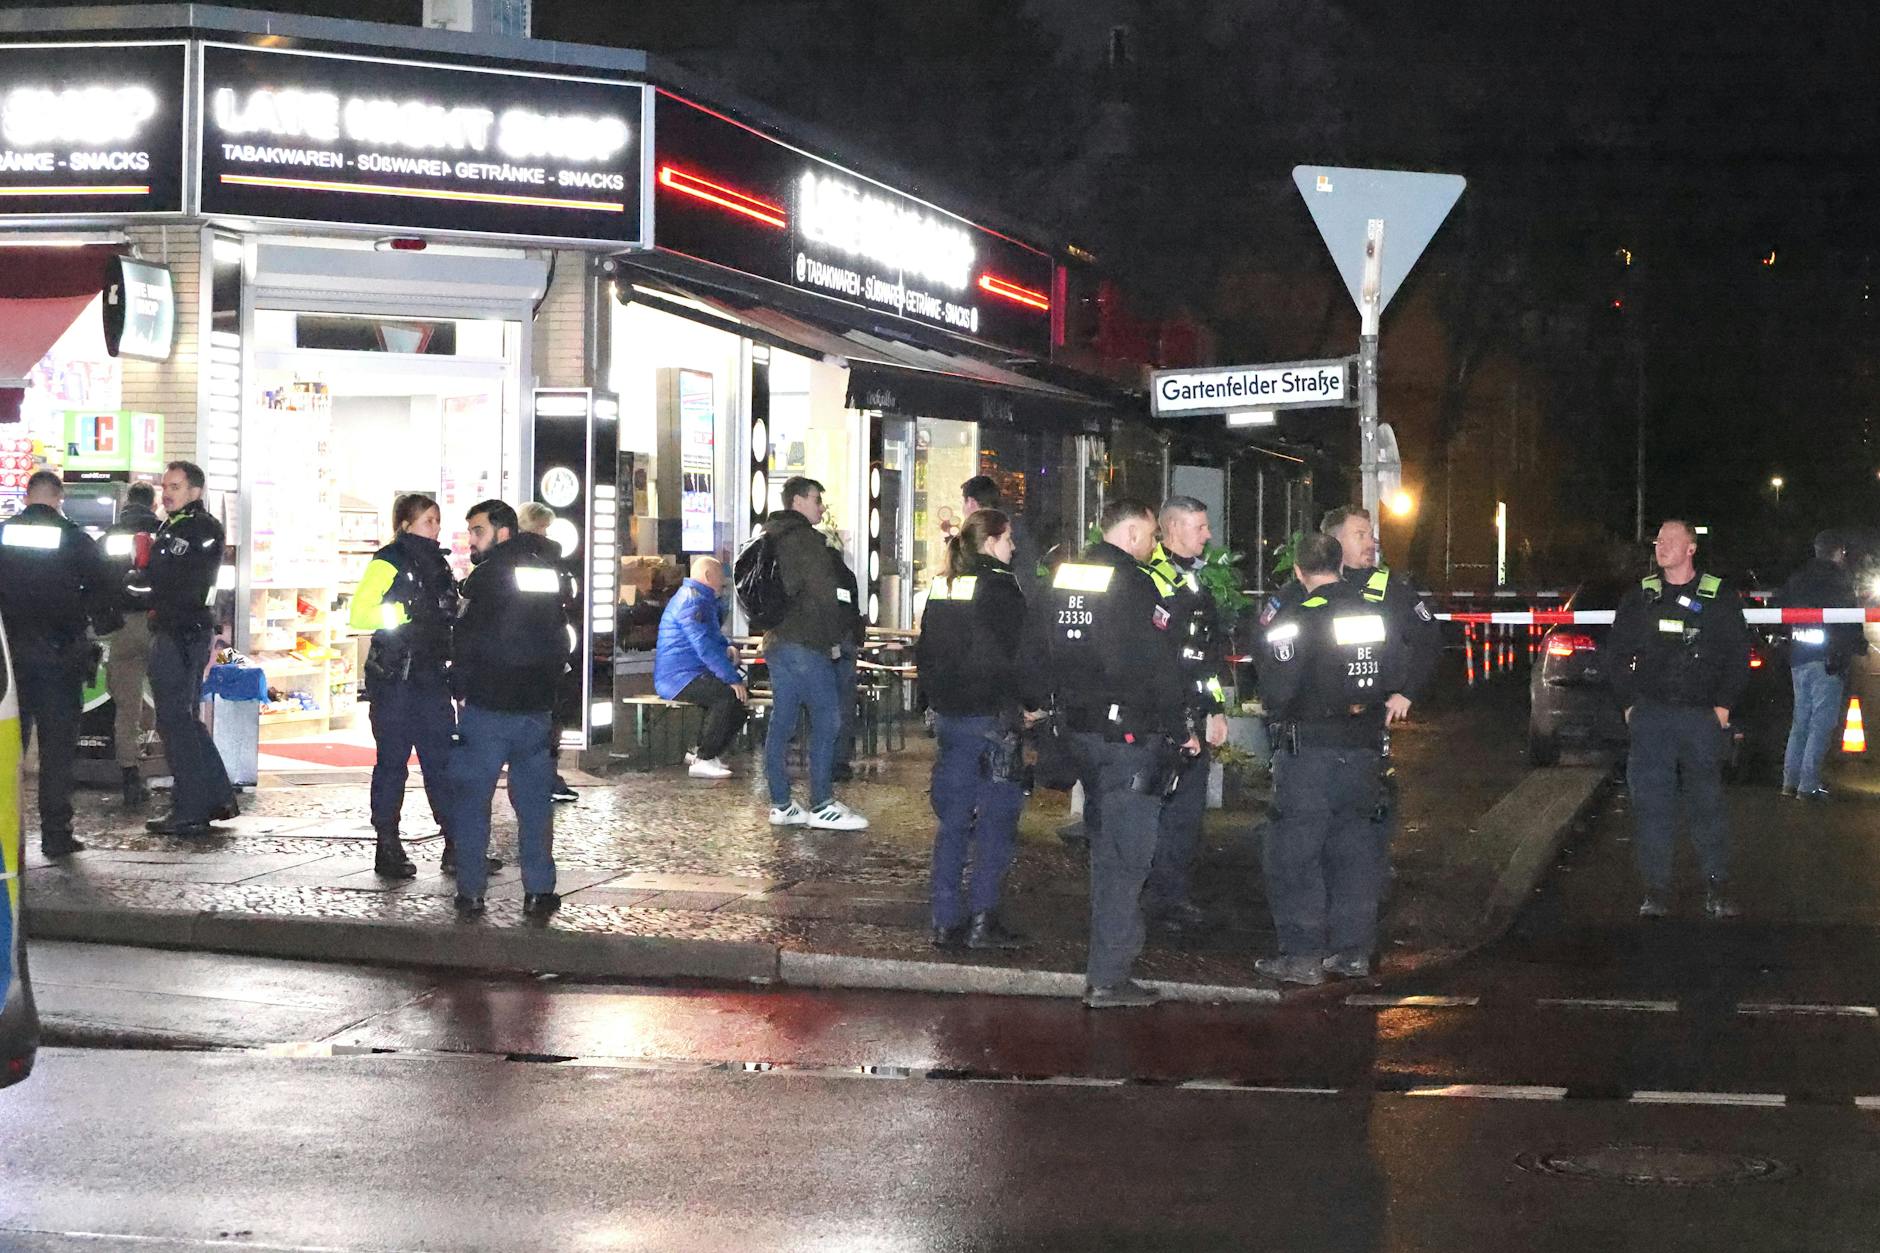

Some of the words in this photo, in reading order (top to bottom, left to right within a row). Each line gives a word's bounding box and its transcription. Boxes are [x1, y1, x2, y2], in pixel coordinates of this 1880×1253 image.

[69, 151, 150, 171] SNACKS
[221, 143, 344, 169] TABAKWAREN
[455, 162, 545, 185] GETRÄNKE
[558, 170, 625, 191] SNACKS
[806, 259, 861, 297] TABAKWAREN
[1162, 374, 1278, 400] Gartenfelder
[1282, 369, 1340, 396] Straße
[1068, 595, 1085, 609] BE
[1058, 610, 1093, 625] 23330
[1357, 647, 1372, 660] BE
[1347, 661, 1379, 676] 23331
